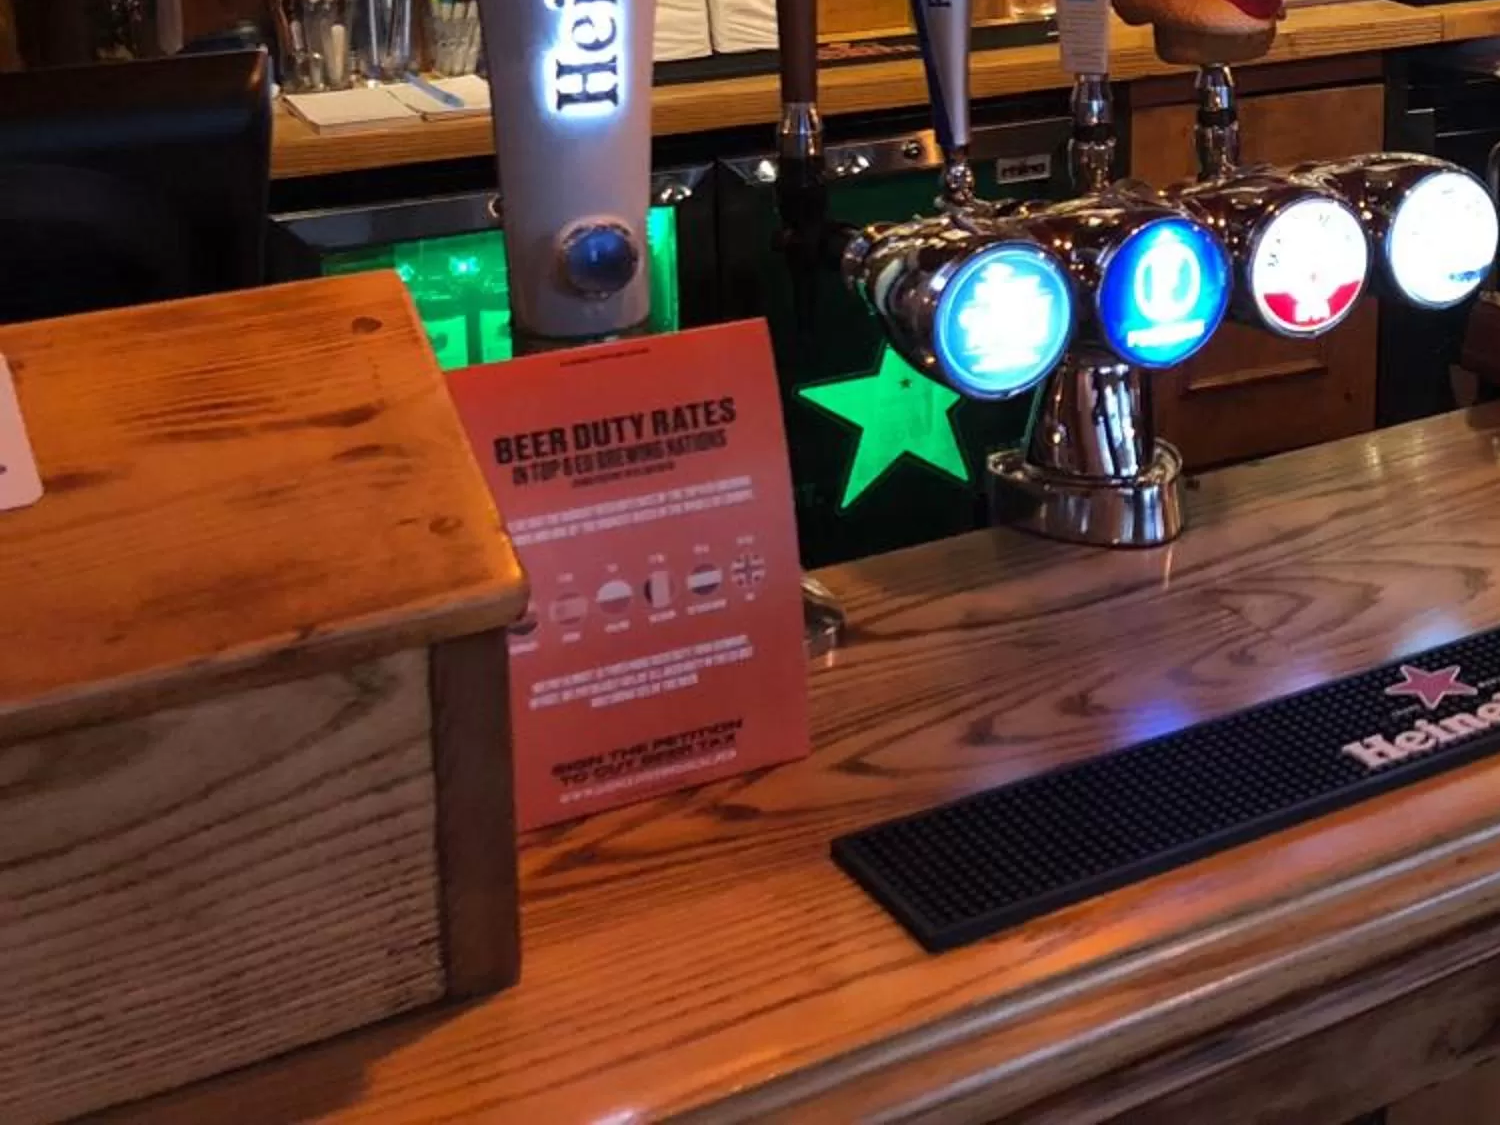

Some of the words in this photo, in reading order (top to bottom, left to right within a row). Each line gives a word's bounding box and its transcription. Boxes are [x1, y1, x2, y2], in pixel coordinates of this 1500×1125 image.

[493, 427, 567, 465] BEER
[572, 413, 645, 452] DUTY
[651, 396, 737, 436] RATES
